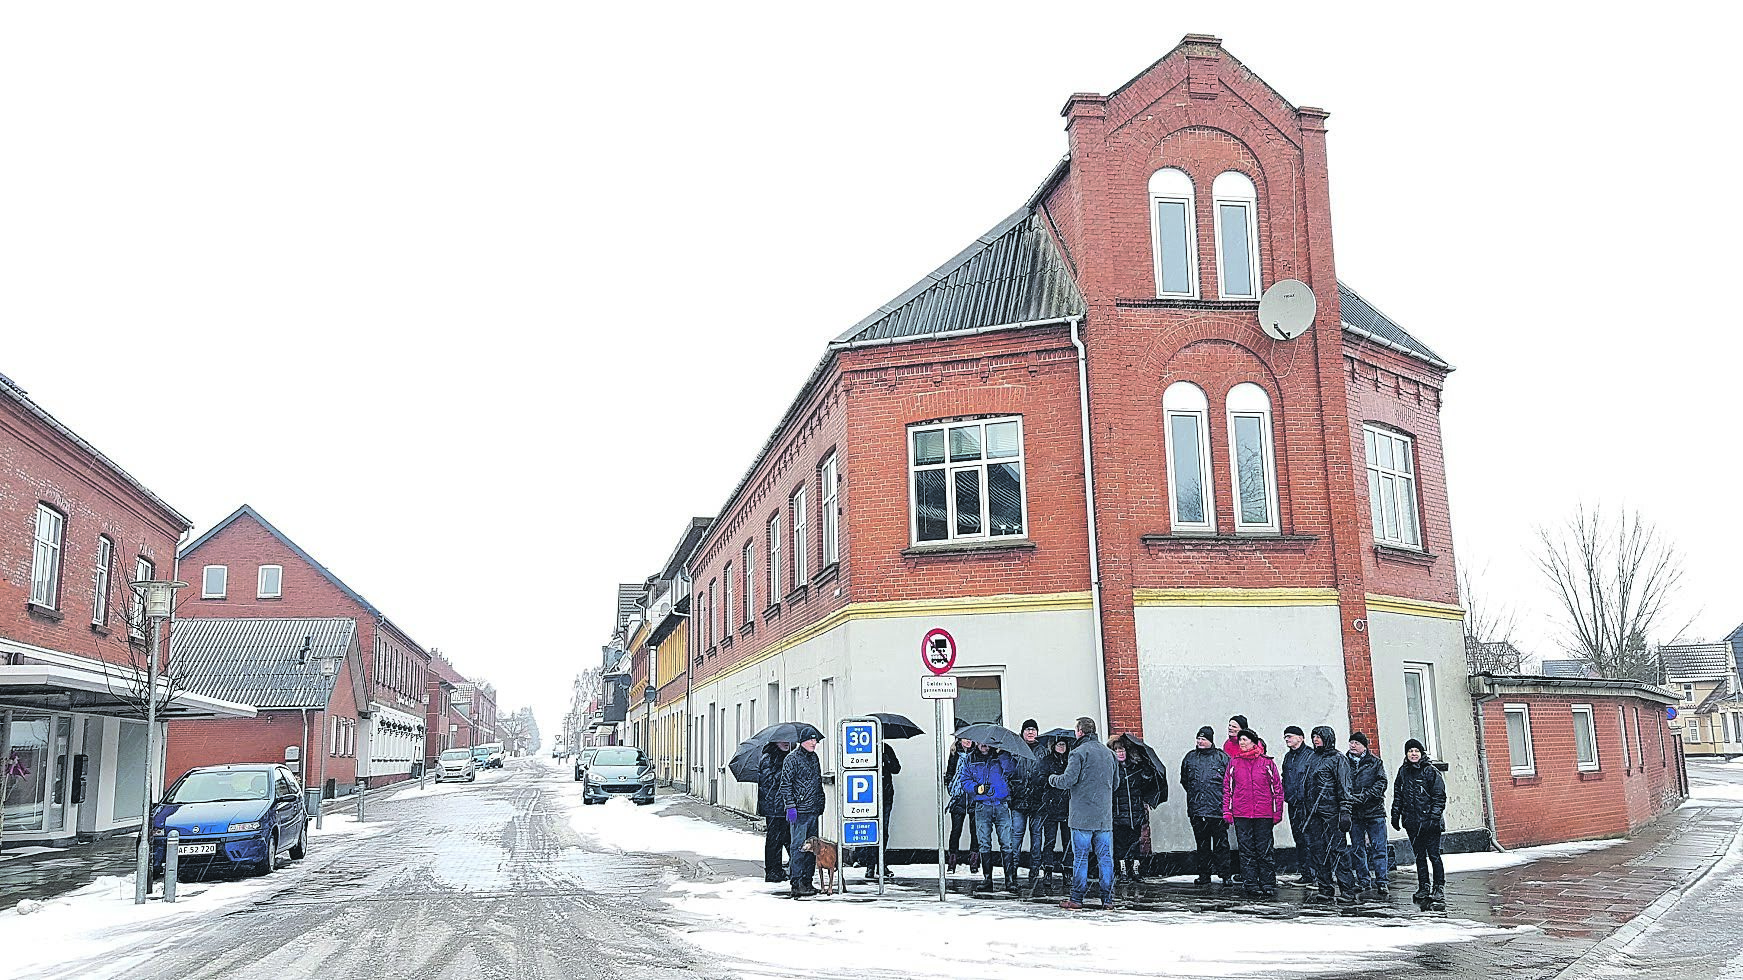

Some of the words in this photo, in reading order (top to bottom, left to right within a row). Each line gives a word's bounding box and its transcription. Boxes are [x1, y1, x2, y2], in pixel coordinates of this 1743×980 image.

[849, 731, 870, 746] 30
[852, 777, 869, 801] P
[178, 846, 188, 854] AF
[189, 846, 199, 854] 52
[200, 845, 215, 853] 720
